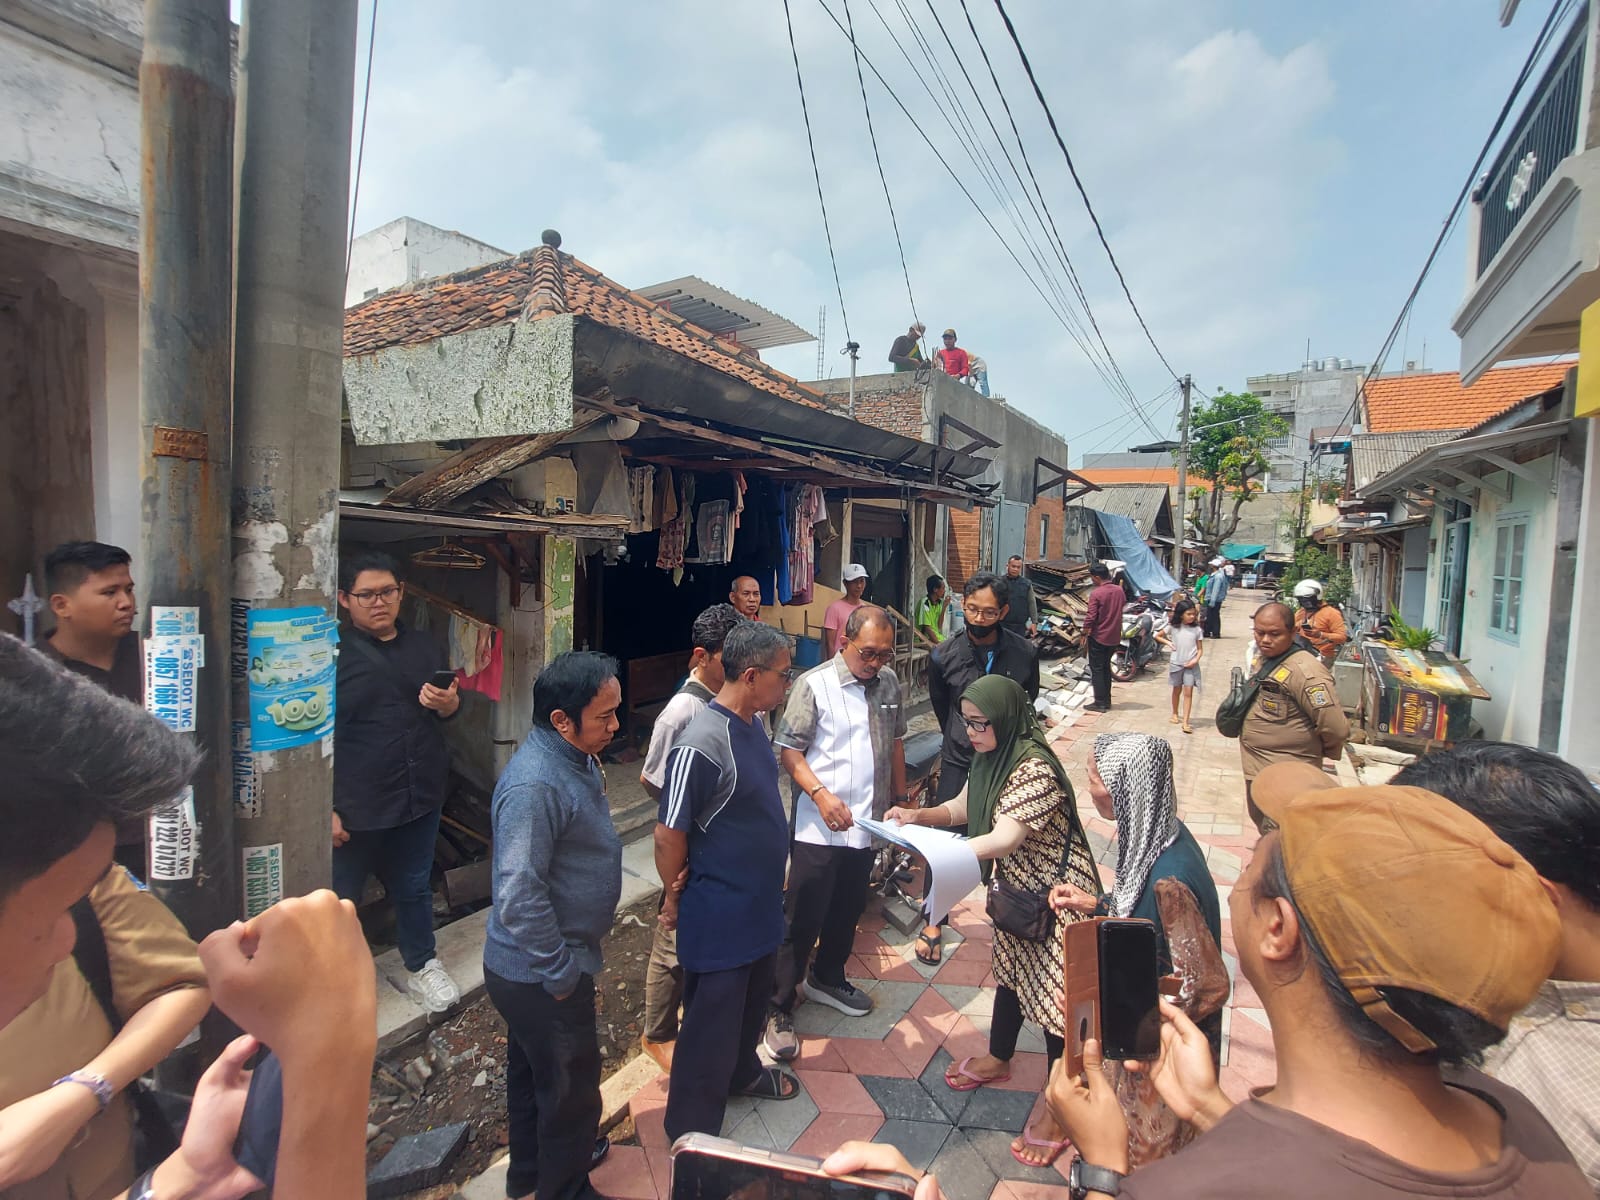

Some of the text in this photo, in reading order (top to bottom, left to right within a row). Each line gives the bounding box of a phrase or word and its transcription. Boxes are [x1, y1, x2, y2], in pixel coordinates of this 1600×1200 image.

[155, 657, 180, 680] 0857
[154, 683, 179, 705] 1666
[181, 662, 193, 728] SEDOT WC
[265, 698, 323, 725] 100
[156, 826, 178, 842] 222
[154, 844, 177, 876] 474737
[179, 856, 190, 875] WC
[270, 858, 280, 893] SEDOT
